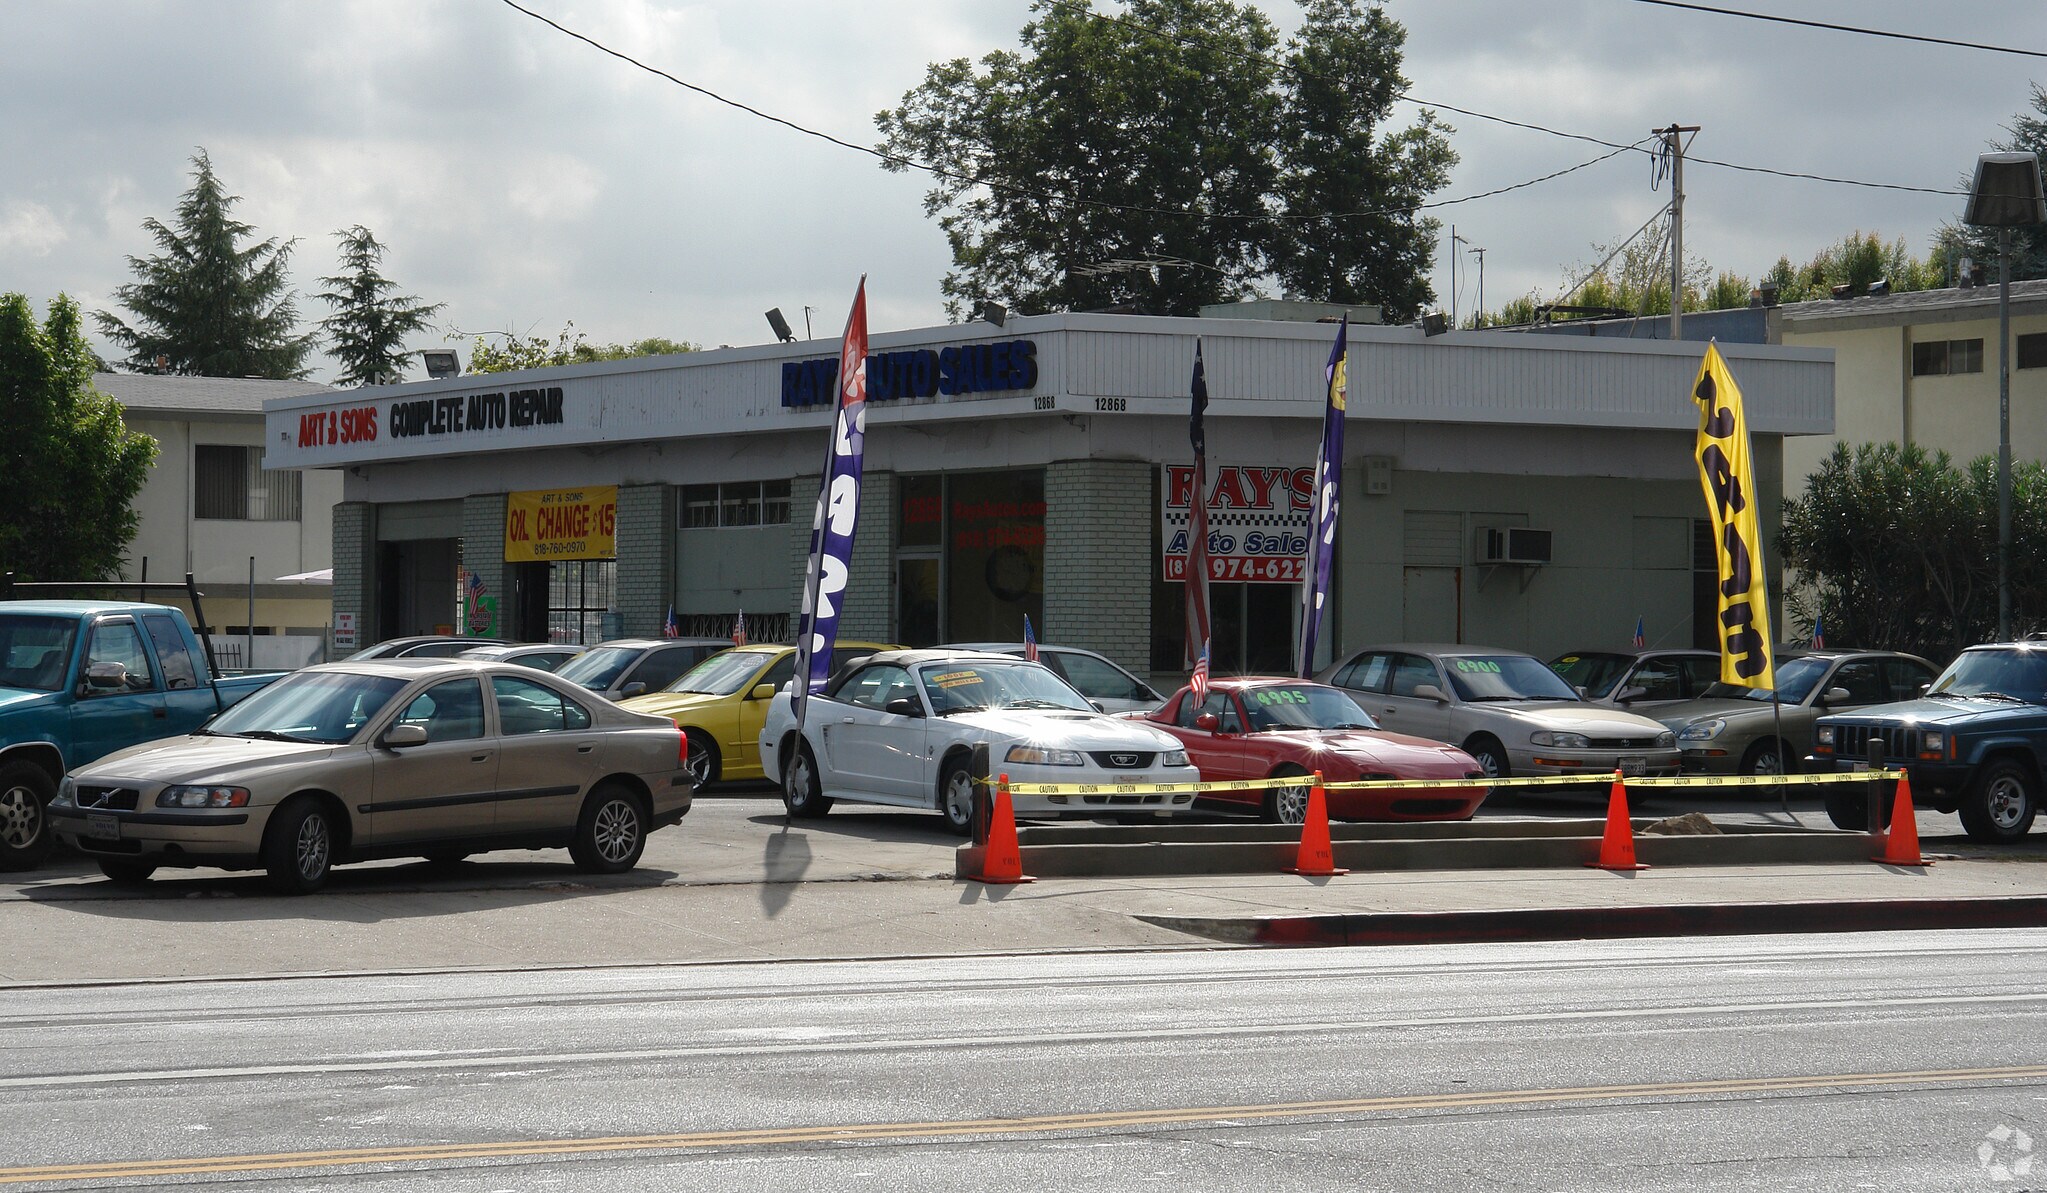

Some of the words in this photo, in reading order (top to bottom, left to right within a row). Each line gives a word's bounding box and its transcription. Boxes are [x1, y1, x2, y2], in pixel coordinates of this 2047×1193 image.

[866, 349, 939, 401] AUTO
[939, 339, 1038, 396] SALES
[1033, 395, 1055, 411] 12868
[1095, 397, 1127, 412] 12868
[390, 397, 463, 438] COMPLETE
[466, 392, 506, 431] AUTO
[509, 387, 564, 428] REPAIR
[298, 412, 326, 447] ART
[327, 410, 338, 444] &
[340, 406, 377, 443] SONS
[1166, 464, 1317, 514] RAY'S
[541, 493, 555, 504] ART
[565, 492, 584, 503] SONS
[509, 508, 530, 542] OIL
[536, 504, 590, 540] CHANGE
[534, 541, 586, 555] 818-760-0970
[1166, 529, 1237, 555] Ato
[1244, 530, 1308, 555] Sale
[1213, 558, 1305, 579] 974-622
[1457, 660, 1502, 673] 4900
[1256, 690, 1308, 706] 4995
[1039, 785, 1060, 794] CAUTION
[1078, 785, 1098, 793] CAUTION
[1116, 785, 1136, 793] CAUTION
[1156, 784, 1175, 792] CAUTION
[1192, 783, 1212, 791] CAUTION
[1230, 782, 1250, 790] CAUTION
[1706, 777, 1723, 785] CAUTION
[1739, 776, 1757, 784] CAUTION
[1771, 776, 1789, 784] CAUTION
[1804, 775, 1821, 783] CAUTION
